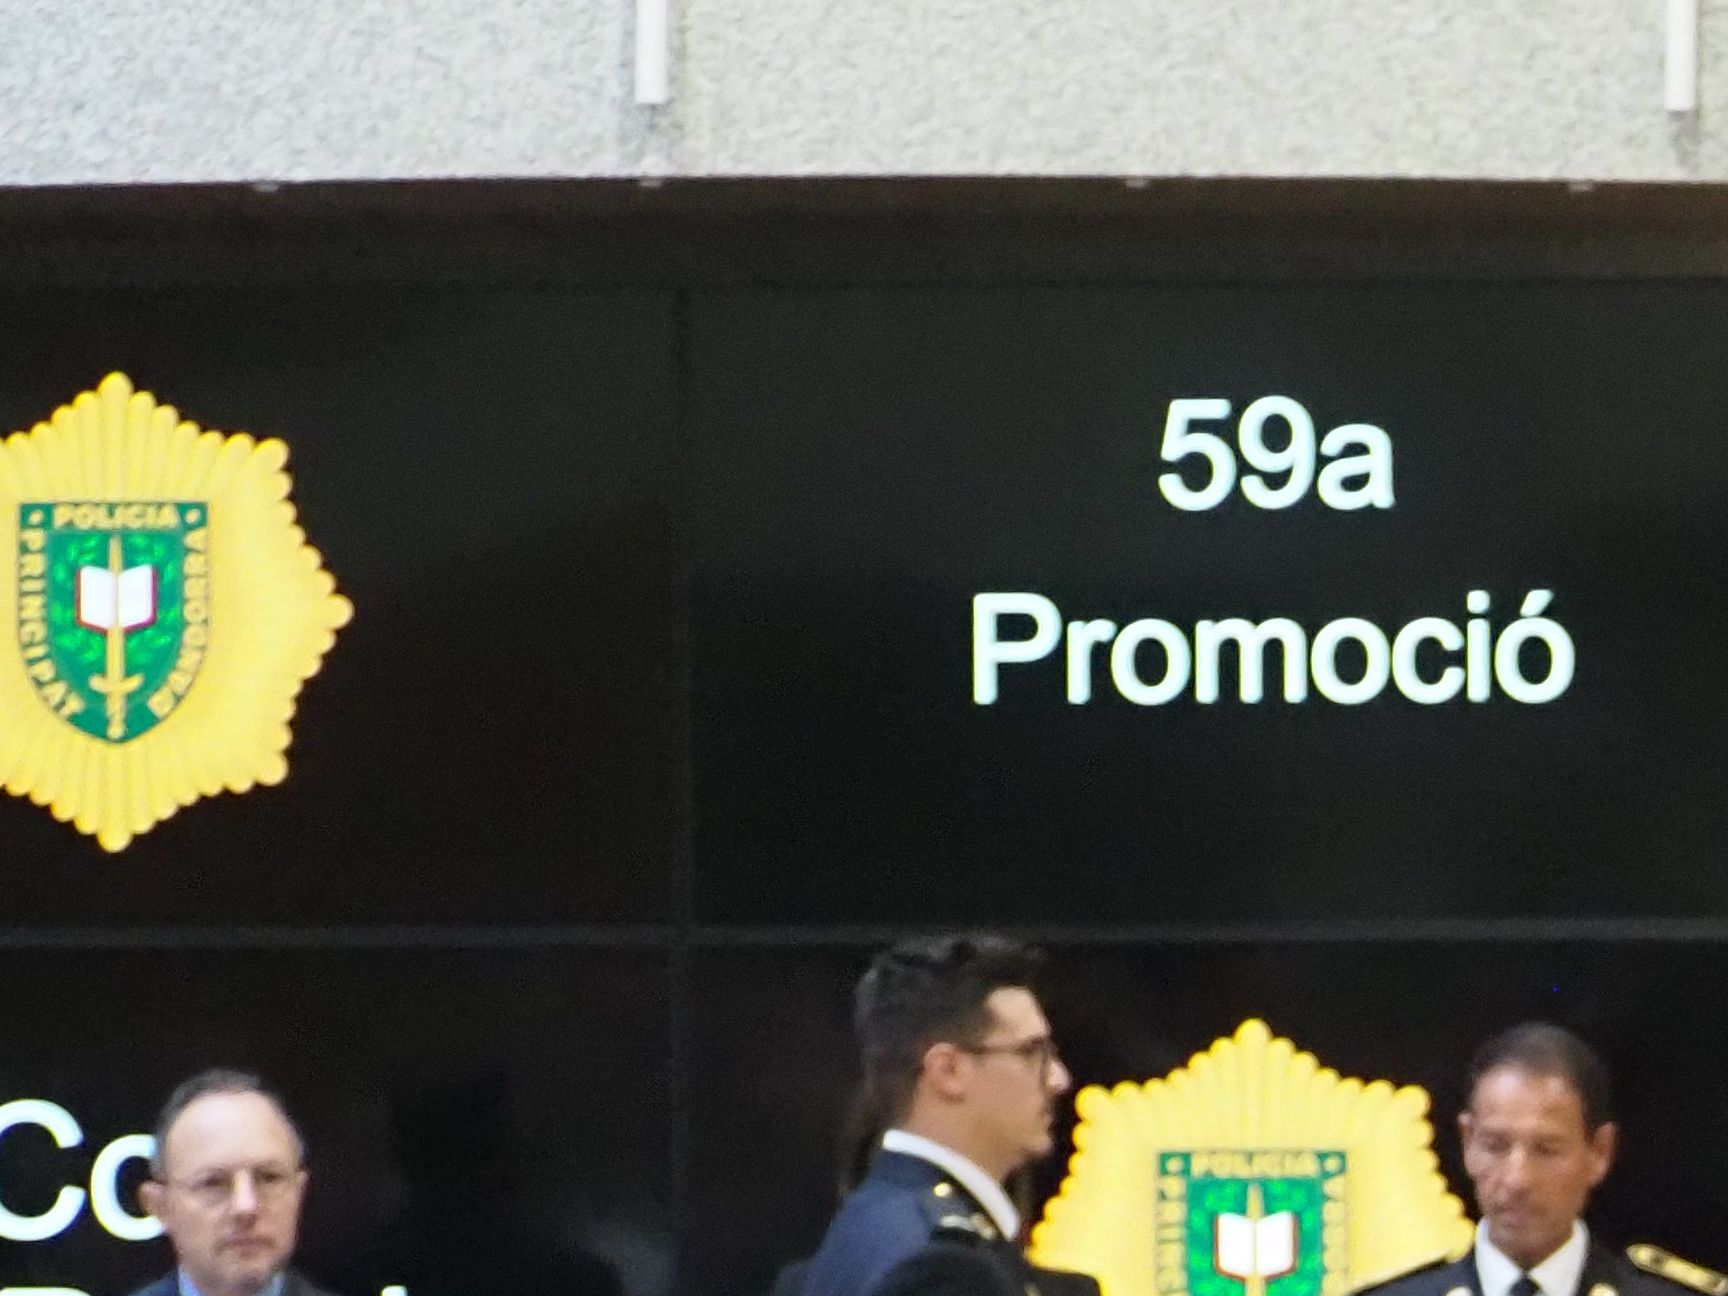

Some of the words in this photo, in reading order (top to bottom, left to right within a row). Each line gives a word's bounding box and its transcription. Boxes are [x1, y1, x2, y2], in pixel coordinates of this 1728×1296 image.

[1159, 396, 1395, 510] 59a
[52, 503, 180, 529] POLICIA
[19, 530, 86, 718] PRINCIPAT
[972, 589, 1576, 704] Promoció
[0, 1099, 168, 1241] Co
